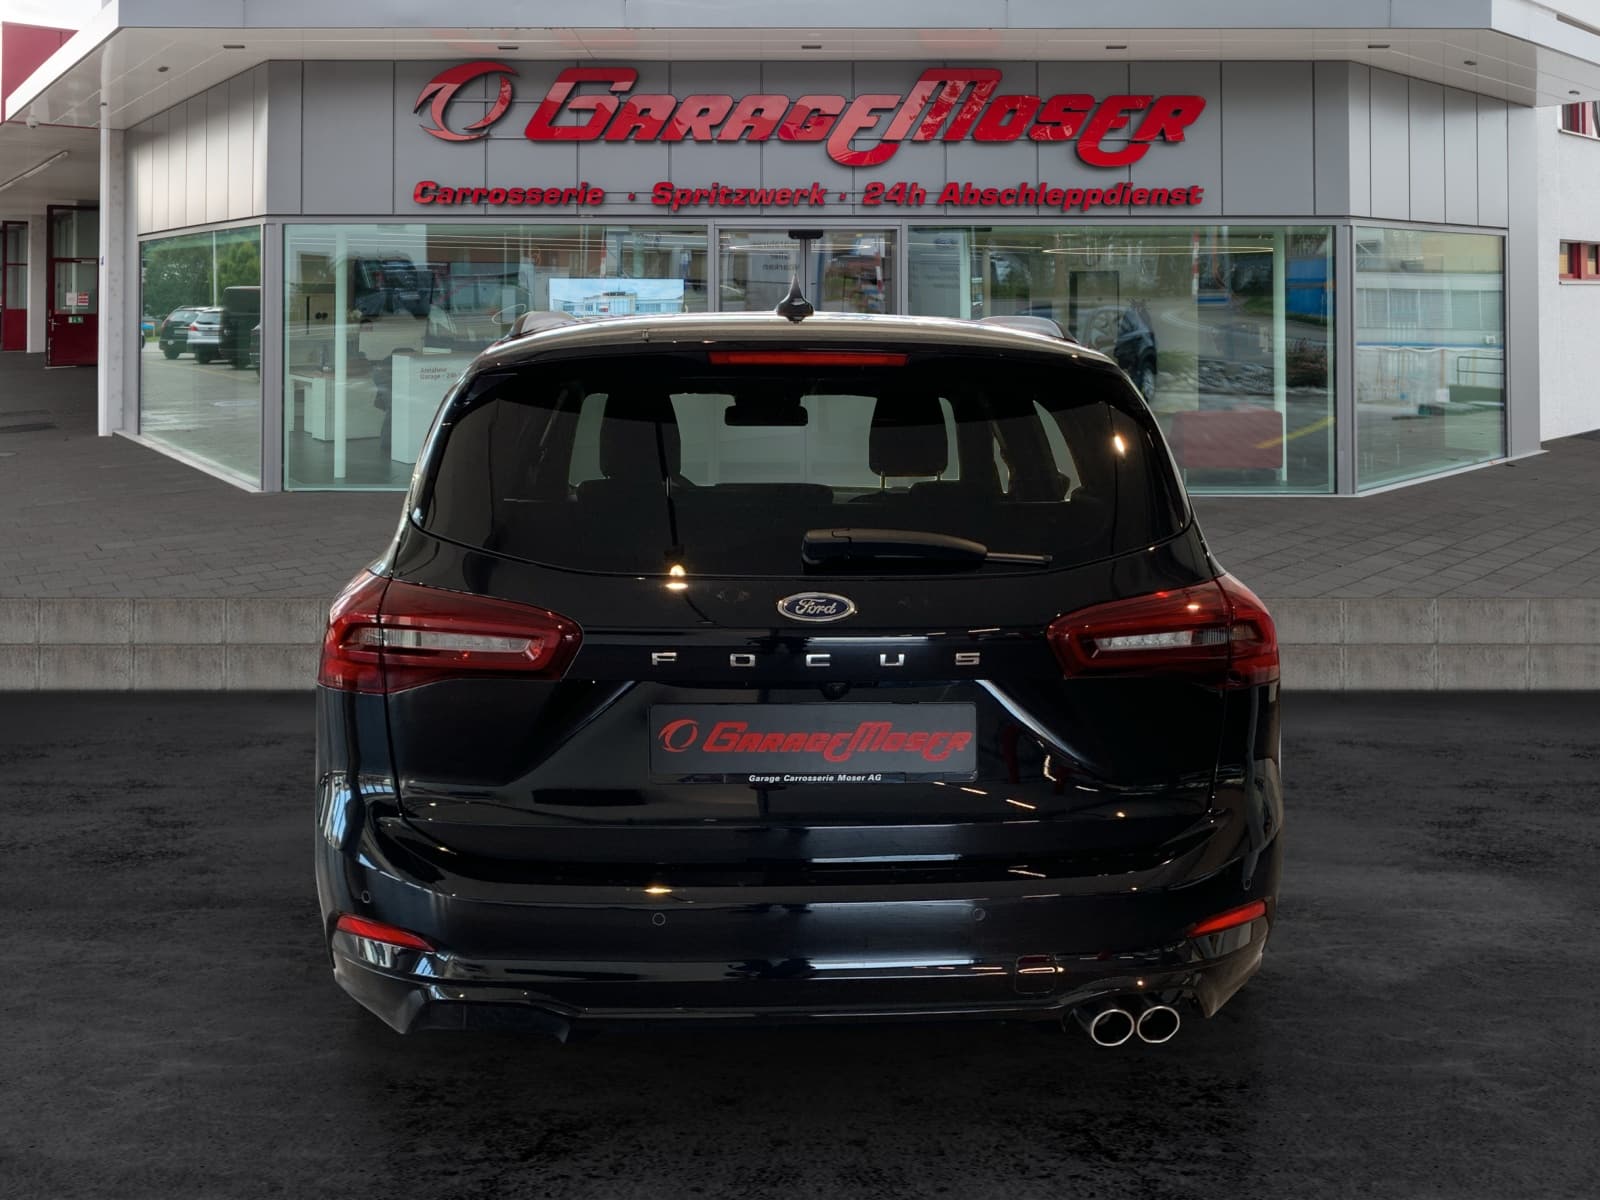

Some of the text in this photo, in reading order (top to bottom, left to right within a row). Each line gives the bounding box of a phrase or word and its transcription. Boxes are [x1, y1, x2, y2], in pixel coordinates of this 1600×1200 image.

[412, 180, 1205, 211] Carrosserie Spritzwerk 24h Abschleppdienst
[795, 598, 837, 614] Ford
[651, 651, 981, 667] FOCUS
[748, 773, 882, 784] Garage Carrosserie Moser AG
